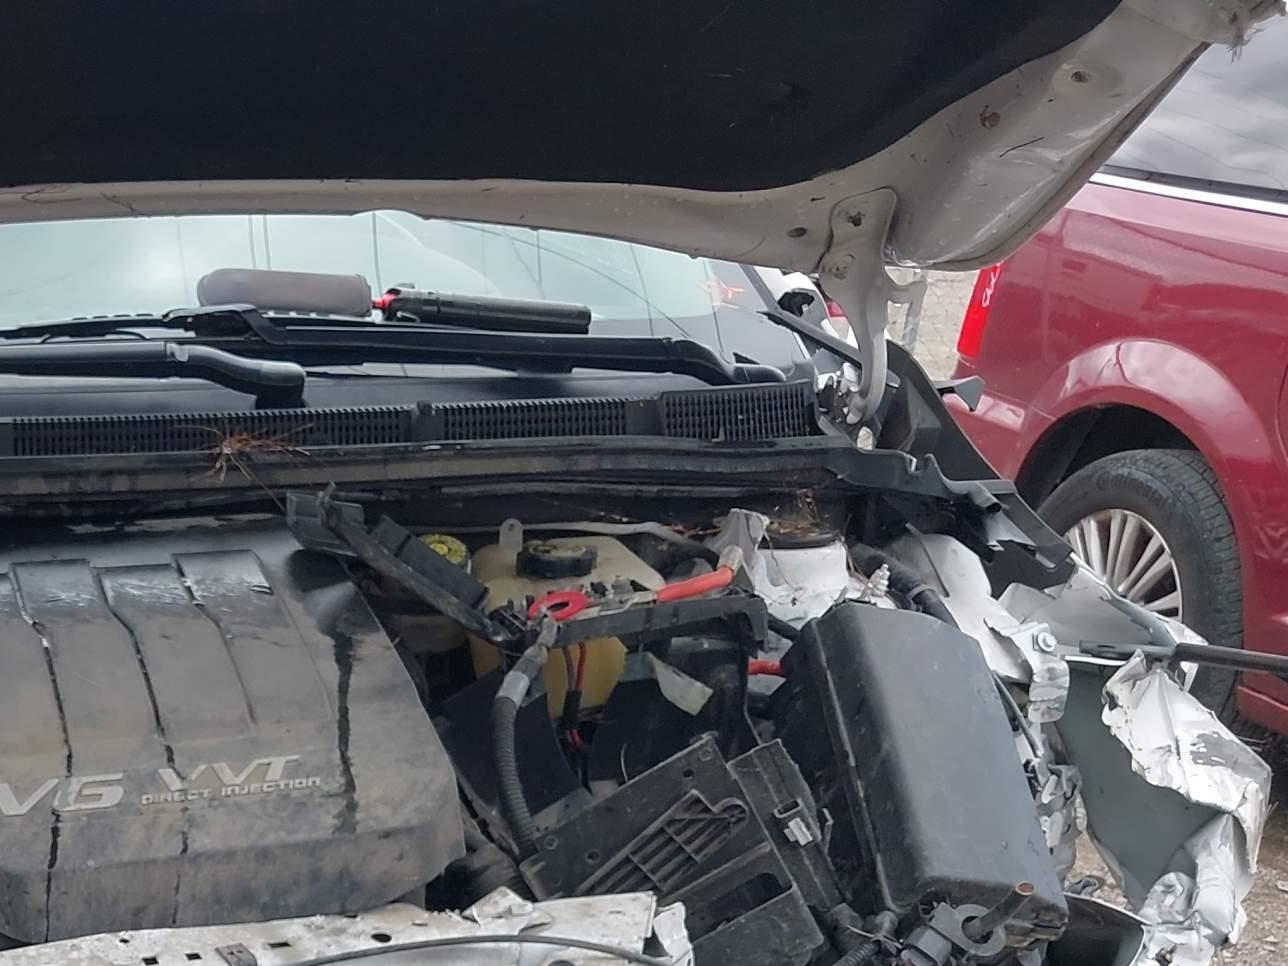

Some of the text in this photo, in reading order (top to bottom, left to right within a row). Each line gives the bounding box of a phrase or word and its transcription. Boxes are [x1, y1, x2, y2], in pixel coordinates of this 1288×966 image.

[157, 755, 300, 791] VVT
[141, 777, 321, 805] DIRECT INJECTION
